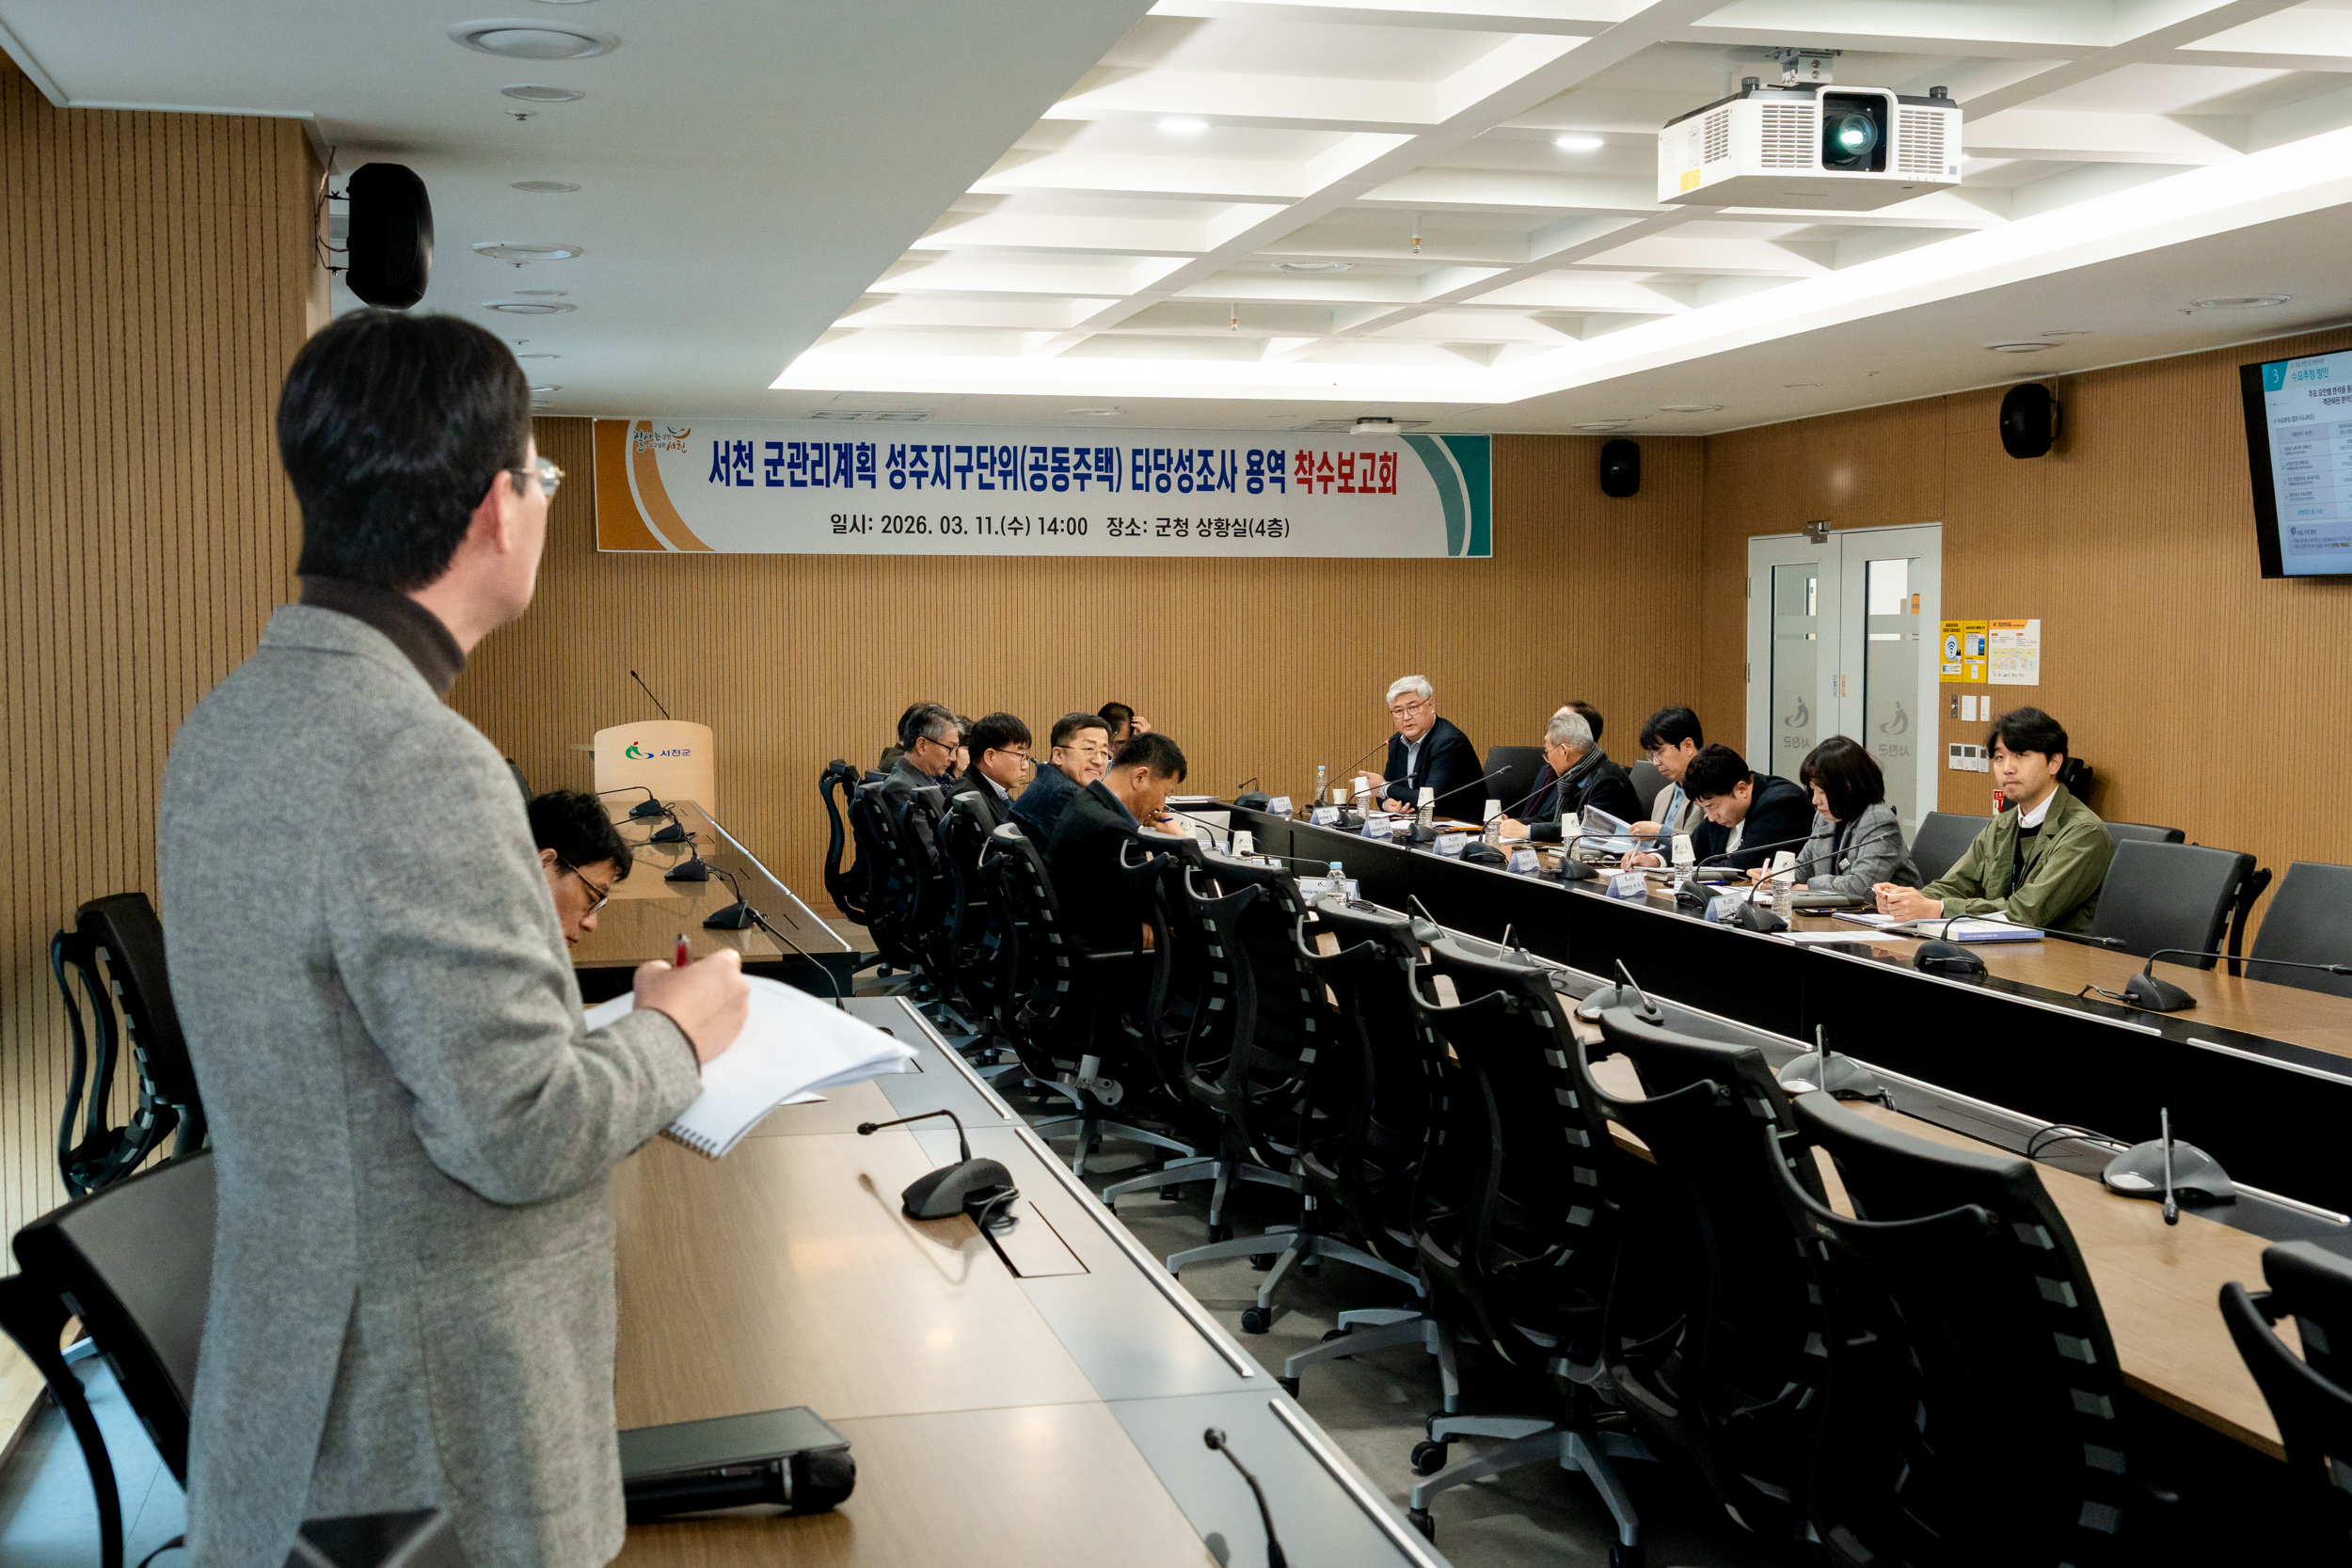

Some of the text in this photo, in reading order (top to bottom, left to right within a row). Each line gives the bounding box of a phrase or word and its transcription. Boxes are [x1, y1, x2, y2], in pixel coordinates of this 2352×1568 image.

[2273, 369, 2279, 383] 3
[2291, 367, 2329, 382] 수요추정 방안
[2309, 384, 2352, 399] 주요 요인별 분석을 통
[633, 430, 661, 452] 잘사는
[666, 439, 688, 453] 서천
[708, 440, 1398, 495] 서천 군관리계획 성주지구단위(공동주택) 타당성조사 용역 착수보고회
[830, 514, 1290, 538] 일시: 2026. 03. 11.(수) 14:00 장소: 군청 상황실(4층)
[660, 749, 691, 757] 서천군
